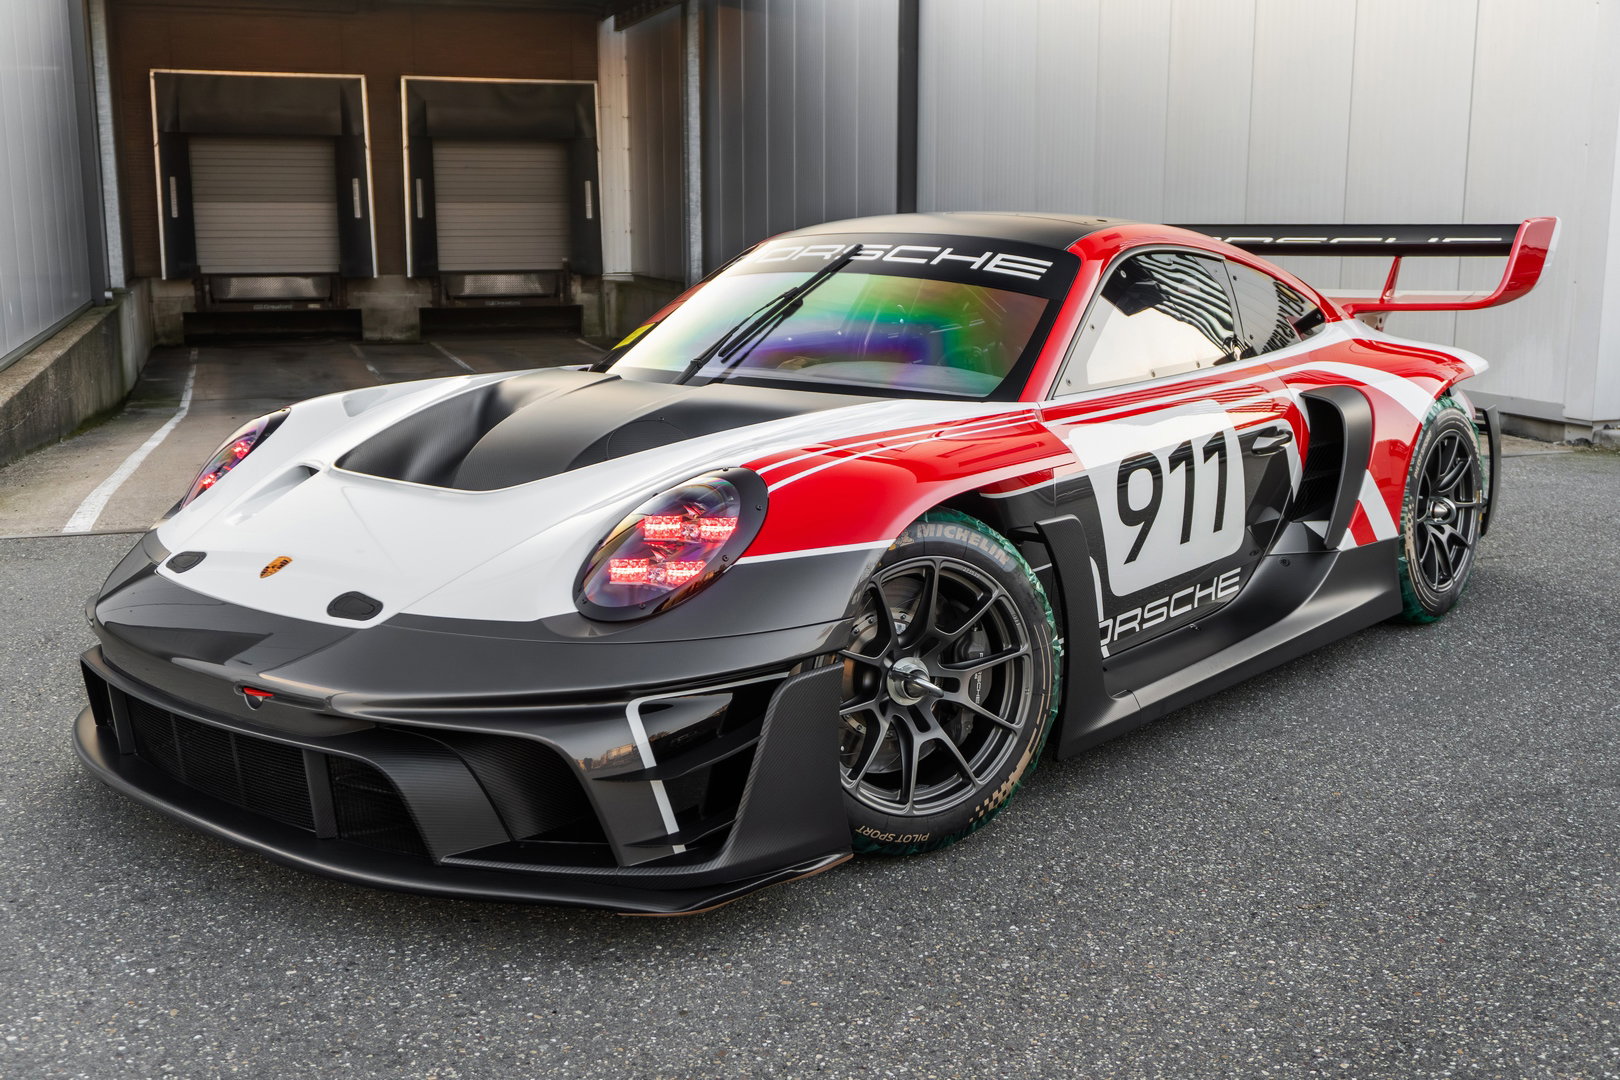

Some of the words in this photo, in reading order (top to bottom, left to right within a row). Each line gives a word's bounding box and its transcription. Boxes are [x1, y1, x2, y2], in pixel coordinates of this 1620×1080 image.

[755, 244, 1053, 281] ORSCHE
[1116, 430, 1229, 566] 911
[916, 523, 1011, 566] MICHELIN
[856, 825, 896, 842] SPORT
[895, 833, 930, 843] PILOT
